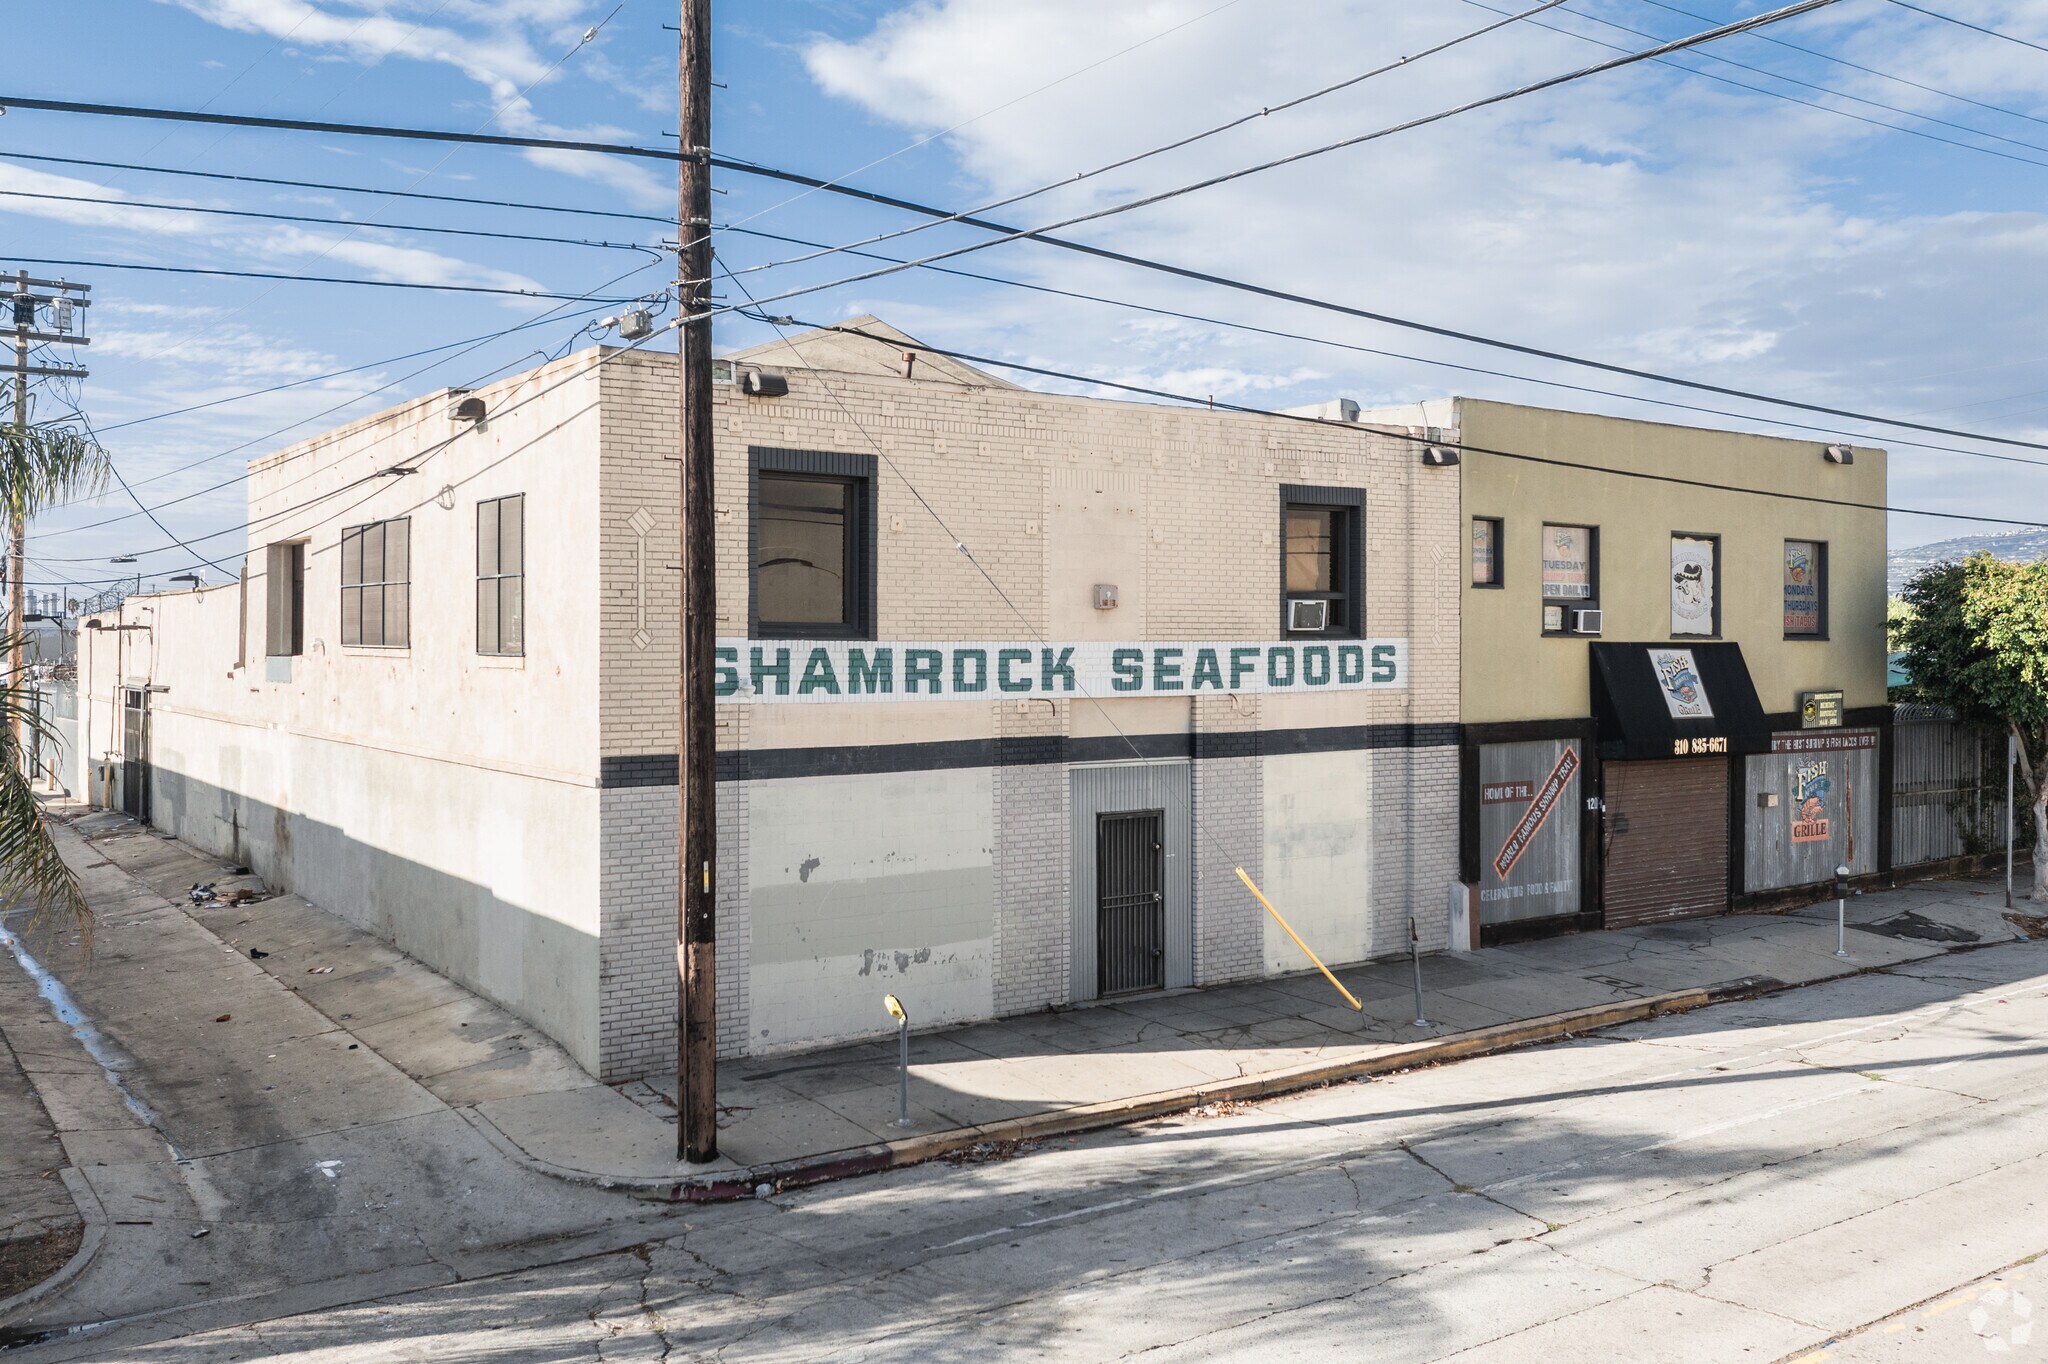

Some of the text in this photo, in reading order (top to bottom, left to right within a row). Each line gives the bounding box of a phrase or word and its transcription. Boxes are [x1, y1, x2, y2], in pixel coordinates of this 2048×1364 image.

[1543, 560, 1586, 570] TUESDAY
[1562, 585, 1589, 597] DAILY!
[1796, 616, 1815, 627] TACOS
[715, 645, 1396, 696] SHAMROCK SEAFOODS
[1661, 655, 1689, 691] FISH
[1674, 737, 1727, 755] 310 835-6671
[1796, 760, 1828, 801] FISH
[1504, 786, 1514, 799] OF
[1516, 807, 1542, 844] FAMOUS
[1539, 778, 1560, 812] SHRIMP
[1557, 756, 1574, 781] TRAY
[1794, 822, 1827, 838] GRILLE
